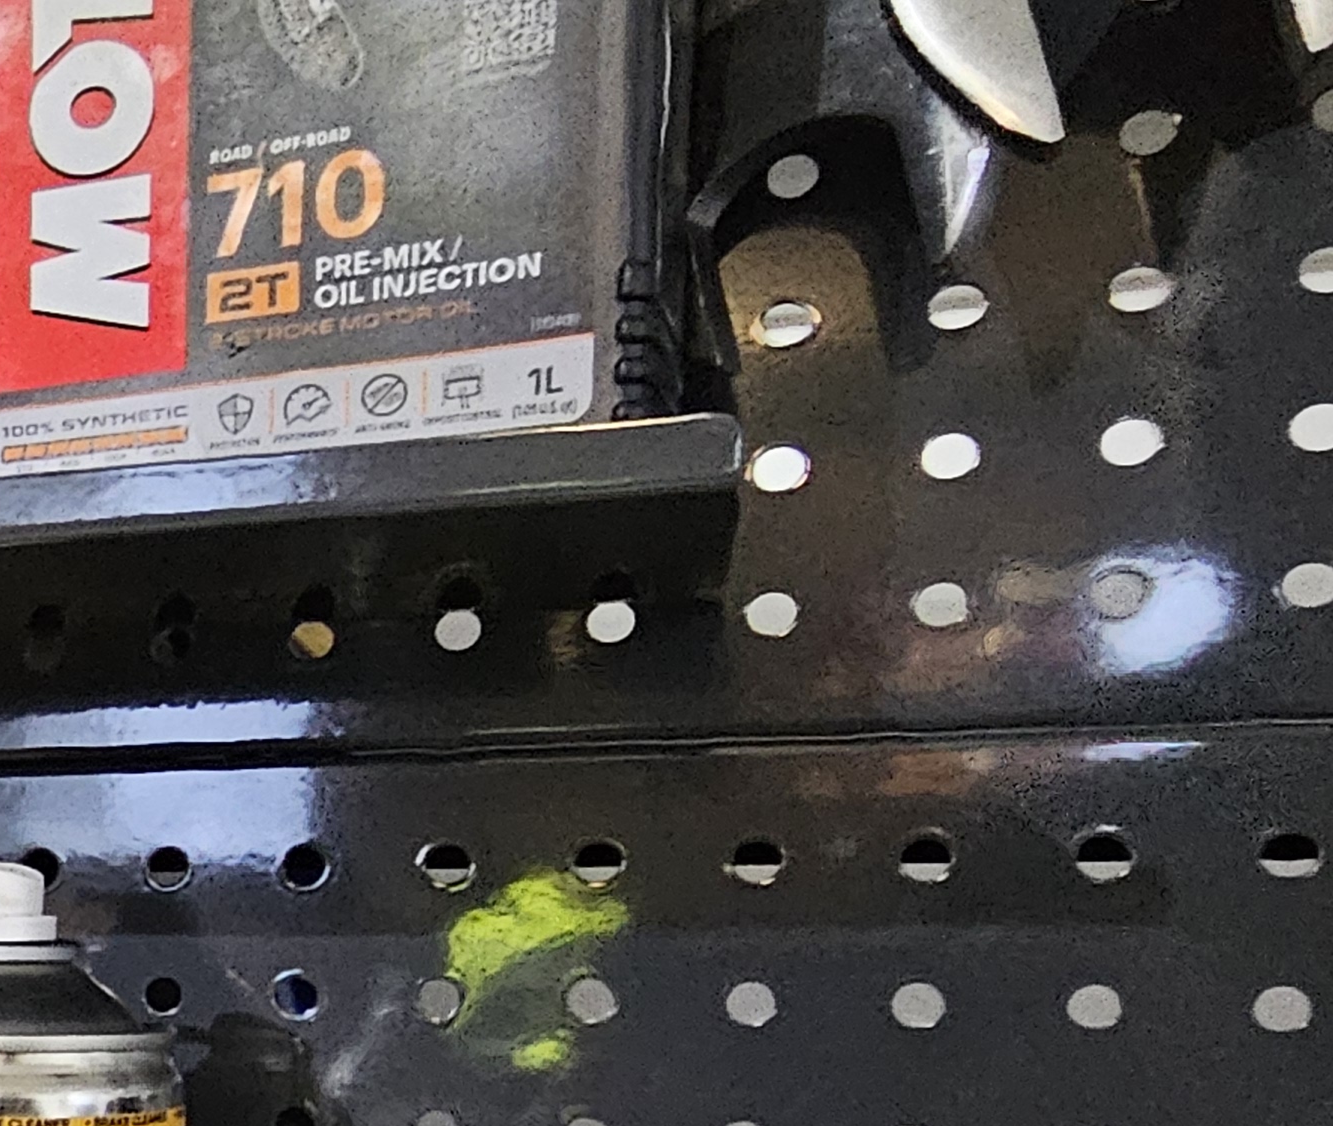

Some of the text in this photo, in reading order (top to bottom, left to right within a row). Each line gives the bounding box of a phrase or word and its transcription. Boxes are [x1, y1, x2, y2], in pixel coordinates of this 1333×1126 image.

[28, 0, 155, 331] MOT
[209, 144, 253, 164] ROAD
[207, 145, 386, 258] 710
[314, 252, 543, 309] OIL INJECTION
[315, 238, 444, 281] PRE-MIX
[219, 272, 289, 313] 2T
[527, 366, 564, 397] 1L
[61, 405, 190, 432] SYNTHETIC
